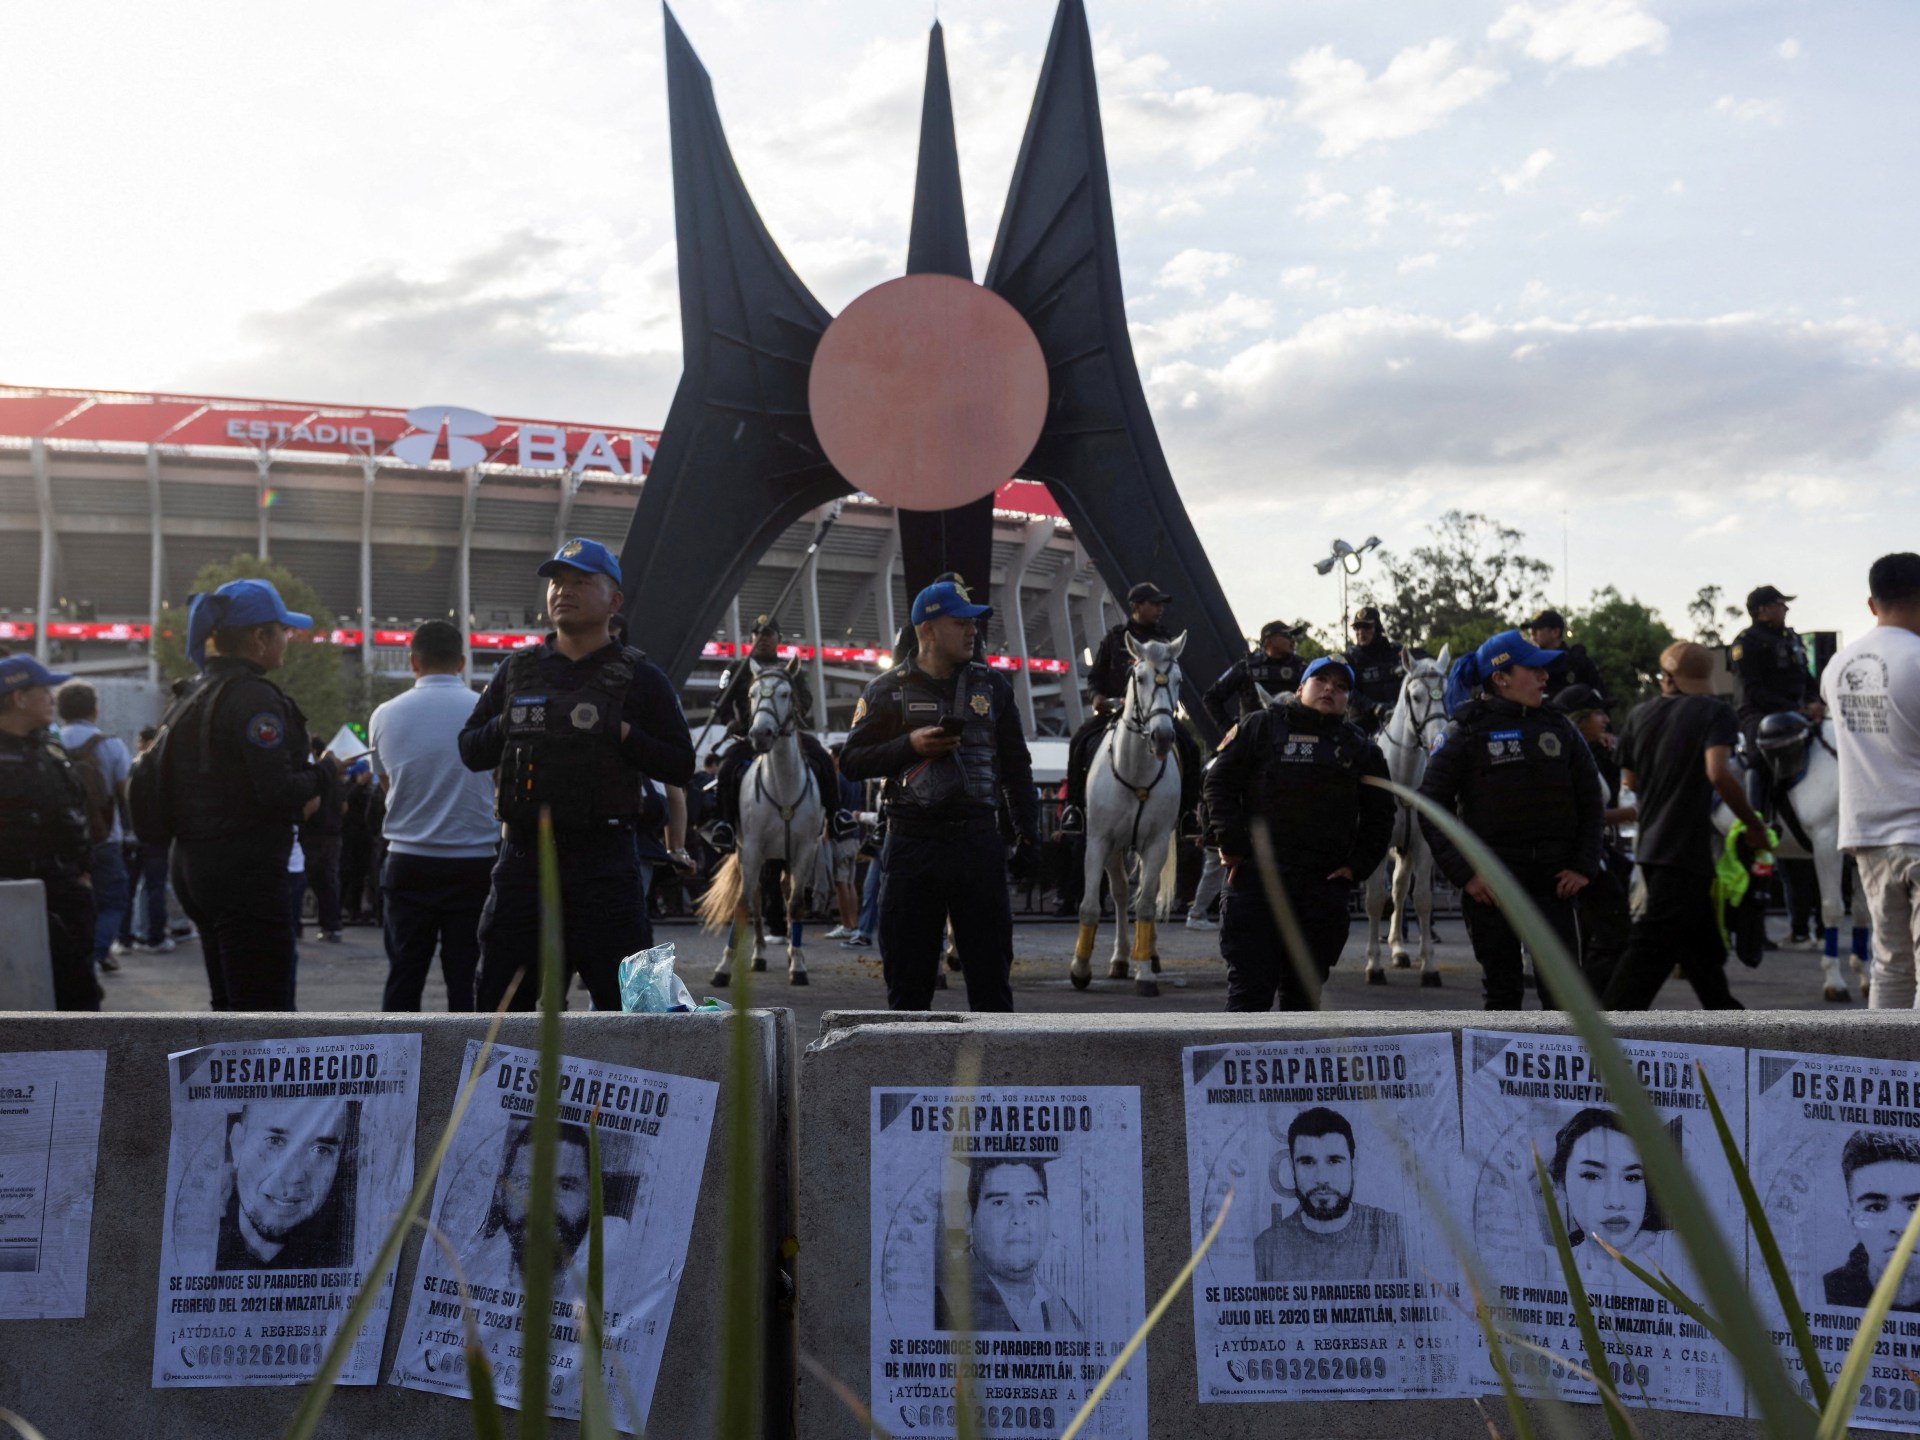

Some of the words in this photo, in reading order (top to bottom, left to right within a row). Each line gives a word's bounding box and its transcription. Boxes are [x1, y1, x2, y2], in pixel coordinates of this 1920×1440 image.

[227, 418, 373, 446] ESTADIO
[350, 1043, 375, 1051] TODOS
[1235, 1049, 1251, 1057] NOS
[1374, 1043, 1400, 1052] TODOS
[1662, 1051, 1690, 1060] TODOS
[210, 1053, 379, 1084] DESAPARECIDO
[1224, 1054, 1407, 1085] DESAPARECIDO
[1804, 1061, 1822, 1070] NOS
[1891, 1069, 1908, 1077] NOS
[188, 1085, 211, 1100] LUIS
[213, 1084, 268, 1099] HUMBERTO
[270, 1082, 336, 1098] VALDELAMAR
[338, 1080, 404, 1096] BUSTAMANTE
[497, 1063, 670, 1118] DESPARECIDO
[643, 1078, 669, 1089] TODOS
[1208, 1088, 1255, 1104] MISRAEL
[1259, 1087, 1313, 1103] ARMANDO
[1316, 1083, 1378, 1101] SEPÚLVEDA
[1381, 1083, 1435, 1100] MACHADO
[1499, 1079, 1550, 1099] YAJAIRA
[1553, 1083, 1591, 1101] SUJEY
[923, 1095, 938, 1103] NOS
[1061, 1094, 1088, 1102] TODOS
[501, 1091, 534, 1113] CÉSAR
[583, 1109, 632, 1133] BRTOLDI
[634, 1118, 661, 1137] PÁEZ
[911, 1105, 1093, 1132] DESAPARECIDO
[1804, 1101, 1835, 1121] SAÚL
[1839, 1106, 1869, 1124] YAEL
[953, 1136, 980, 1152] ALEX
[985, 1133, 1026, 1152] PELÁEZ
[1029, 1136, 1059, 1152] SOTO
[169, 1276, 182, 1291] SE
[185, 1274, 244, 1290] DESCONOCE
[247, 1274, 261, 1289] SU
[263, 1273, 317, 1289] PARADERO
[320, 1272, 351, 1288] DESDE
[424, 1275, 438, 1292] SE
[502, 1291, 516, 1308] SU
[171, 1298, 216, 1314] FEBRERO
[219, 1298, 238, 1312] DEL
[241, 1297, 267, 1312] 2021
[269, 1297, 282, 1312] EN
[285, 1292, 344, 1312] MAZATLÁN,
[1206, 1287, 1220, 1303] SE
[1224, 1286, 1290, 1302] DESCONOCE
[1292, 1285, 1308, 1301] SU
[1311, 1284, 1371, 1301] PARADERO
[1374, 1283, 1410, 1300] DESDE
[1413, 1283, 1427, 1299] EL
[1500, 1286, 1519, 1301] FUE
[1523, 1287, 1568, 1305] PRIVADA
[1588, 1293, 1602, 1308] SU
[1605, 1293, 1654, 1313] LIBERTAD
[1658, 1299, 1671, 1315] EL
[428, 1299, 461, 1320] MAYO
[483, 1310, 513, 1330] 2023
[1218, 1310, 1251, 1326] JULIO
[1254, 1309, 1275, 1325] DEL
[1278, 1308, 1310, 1325] 2020
[1313, 1308, 1328, 1324] EN
[1331, 1304, 1397, 1325] MAZATLÁN,
[1400, 1305, 1452, 1323] SINALOA.
[1546, 1310, 1566, 1327] DEL
[1598, 1315, 1612, 1331] EN
[1615, 1317, 1676, 1339] MAZATLÁN,
[1814, 1312, 1861, 1331] PRIVADO
[1882, 1319, 1897, 1335] SU
[171, 1323, 236, 1344] ¡AYÚDALO
[244, 1327, 252, 1338] A
[261, 1325, 327, 1338] REGRESAR
[199, 1343, 323, 1367] 6693262089
[491, 1343, 499, 1354] A
[890, 1340, 904, 1355] SE
[907, 1339, 972, 1355] DESCONOCE
[974, 1340, 989, 1355] SU
[993, 1340, 1051, 1356] PARADERO
[1055, 1341, 1091, 1357] DESDE
[1094, 1341, 1107, 1357] EL
[1215, 1336, 1286, 1357] ¡AYÚDALO
[1296, 1339, 1305, 1350] A
[1314, 1337, 1388, 1351] REGRESAR
[1397, 1338, 1407, 1350] A
[1561, 1338, 1570, 1350] A
[1663, 1348, 1672, 1360] A
[1893, 1343, 1907, 1358] EN
[885, 1362, 900, 1378] DE
[903, 1362, 936, 1378] MAYO
[939, 1363, 958, 1378] DEL
[963, 1363, 991, 1379] 2021
[994, 1363, 1009, 1379] EN
[1012, 1360, 1077, 1382] MAZATLÁN,
[1247, 1356, 1387, 1381] 6693262089
[986, 1387, 1058, 1400] REGRESAR
[1067, 1389, 1077, 1400] A
[919, 1405, 1056, 1429] 669262089
